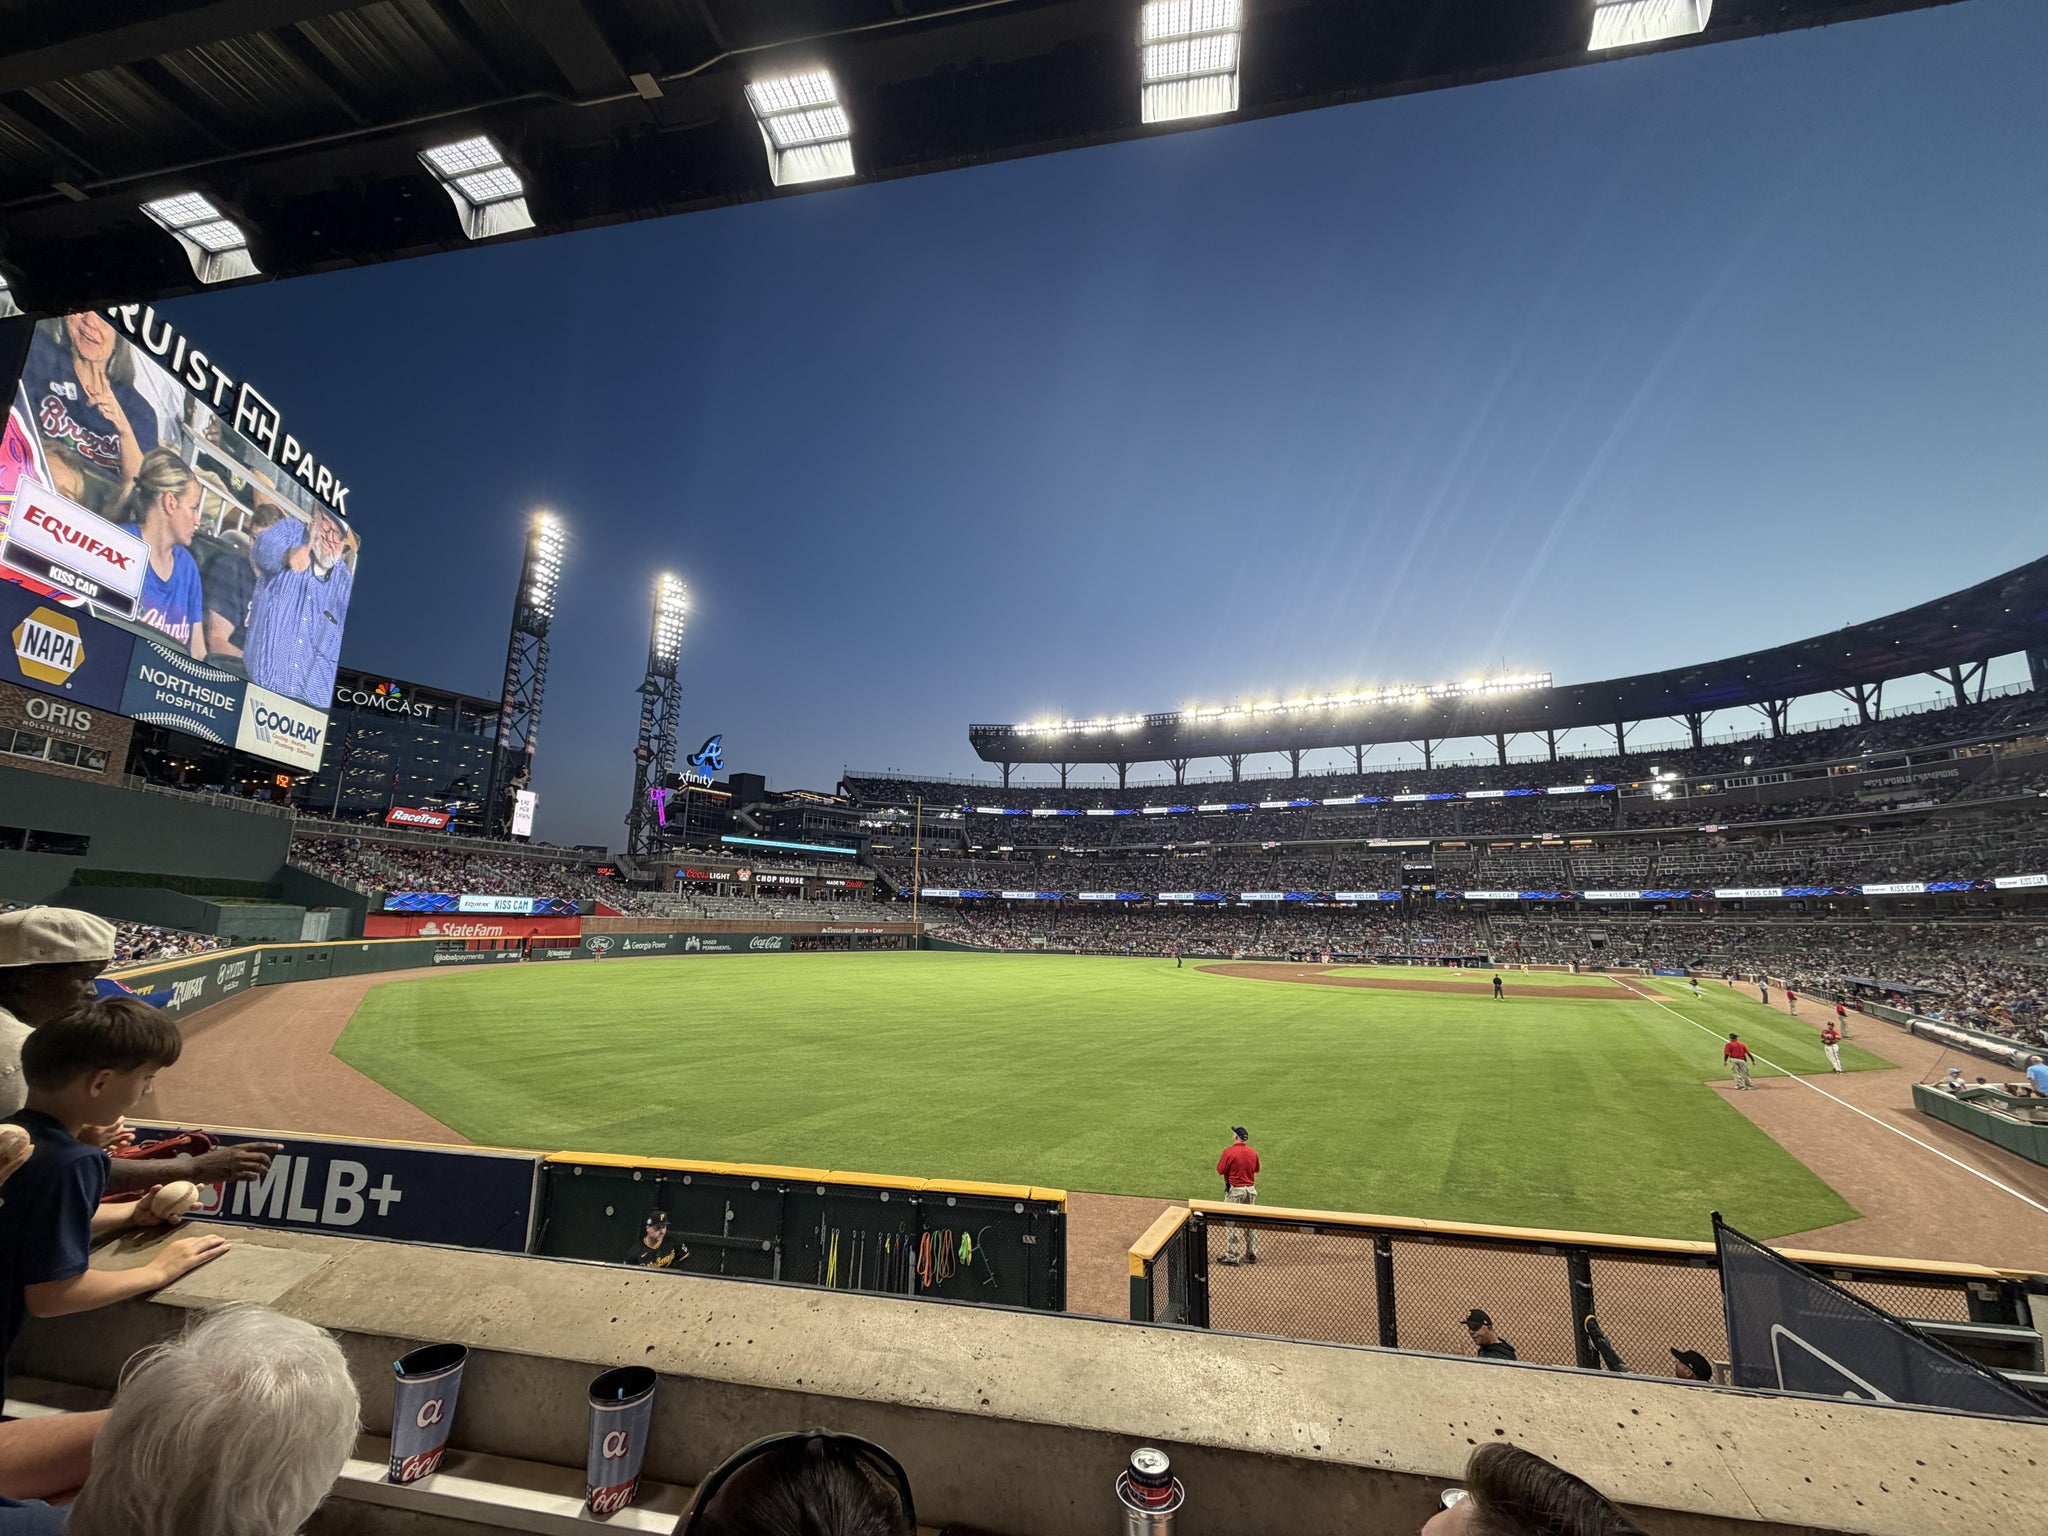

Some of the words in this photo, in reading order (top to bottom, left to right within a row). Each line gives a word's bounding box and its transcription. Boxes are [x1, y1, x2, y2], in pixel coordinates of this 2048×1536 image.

[107, 303, 234, 408] RUIST
[282, 434, 350, 517] PARK
[23, 504, 131, 571] EQUIFAX
[49, 565, 75, 587] KISS
[75, 578, 98, 597] CAM
[24, 623, 77, 668] NAPA
[139, 664, 236, 712] NORTHSIDE
[337, 688, 433, 719] COMCAST
[26, 698, 92, 731] ORIS
[155, 690, 216, 719] HOSPITAL
[255, 707, 322, 745] COOLRAY
[679, 770, 715, 788] xfinity
[391, 810, 443, 826] RaceTrac
[686, 868, 709, 879] Coors
[709, 872, 731, 880] LIGHT
[756, 874, 777, 883] CHOP
[779, 876, 804, 885] HOUSE
[494, 899, 511, 910] KISS
[513, 900, 529, 911] CAM
[590, 938, 610, 949] Ford
[631, 941, 651, 951] Georgia
[651, 941, 667, 949] Power
[166, 975, 207, 1011] EQUIFAX
[231, 1154, 402, 1227] MLB+
